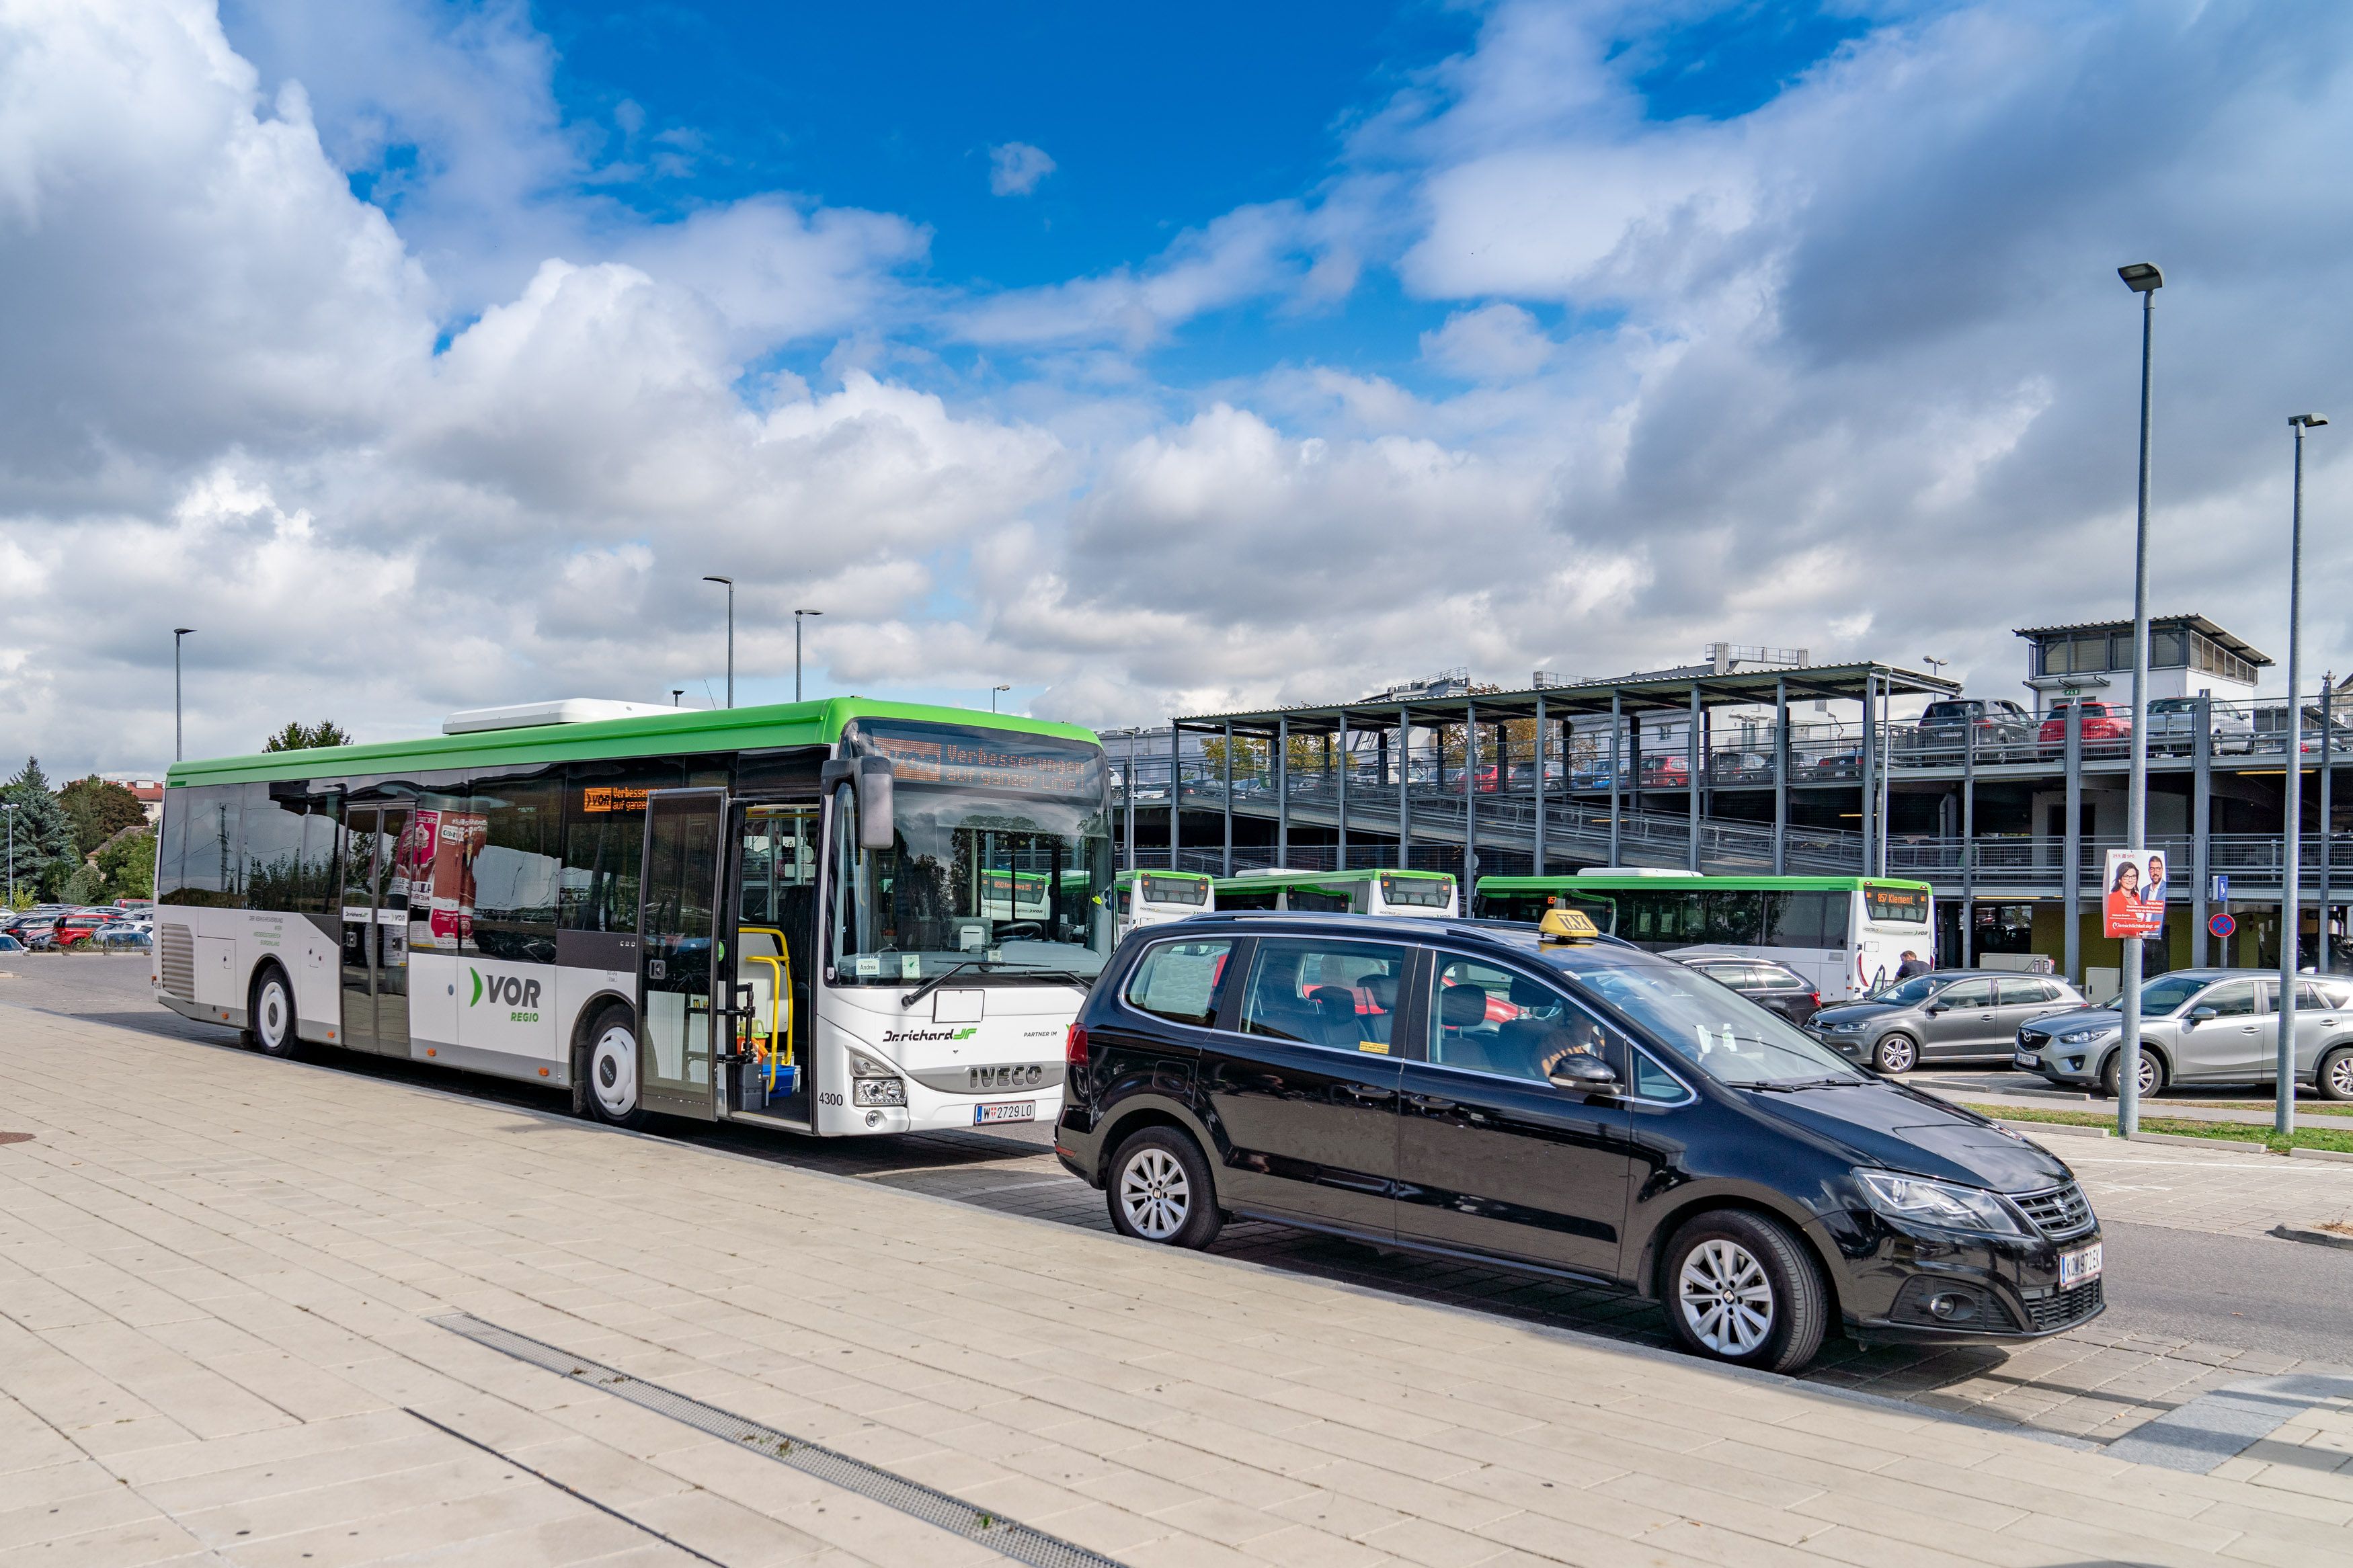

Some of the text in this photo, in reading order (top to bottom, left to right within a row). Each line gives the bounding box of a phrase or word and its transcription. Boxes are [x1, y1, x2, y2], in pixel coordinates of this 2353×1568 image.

[947, 744, 1084, 774] Verbesserungen
[947, 768, 975, 782] auf
[981, 771, 1037, 788] ganzer
[1878, 893, 1888, 903] 857
[395, 914, 406, 922] VOR
[1557, 915, 1593, 930] TAXI
[486, 975, 541, 1009] VOR
[510, 1012, 539, 1022] REGIO
[602, 1063, 614, 1081] IVECO
[970, 1064, 1043, 1088] IVECO
[819, 1092, 844, 1106] 4300
[984, 1107, 990, 1120] W
